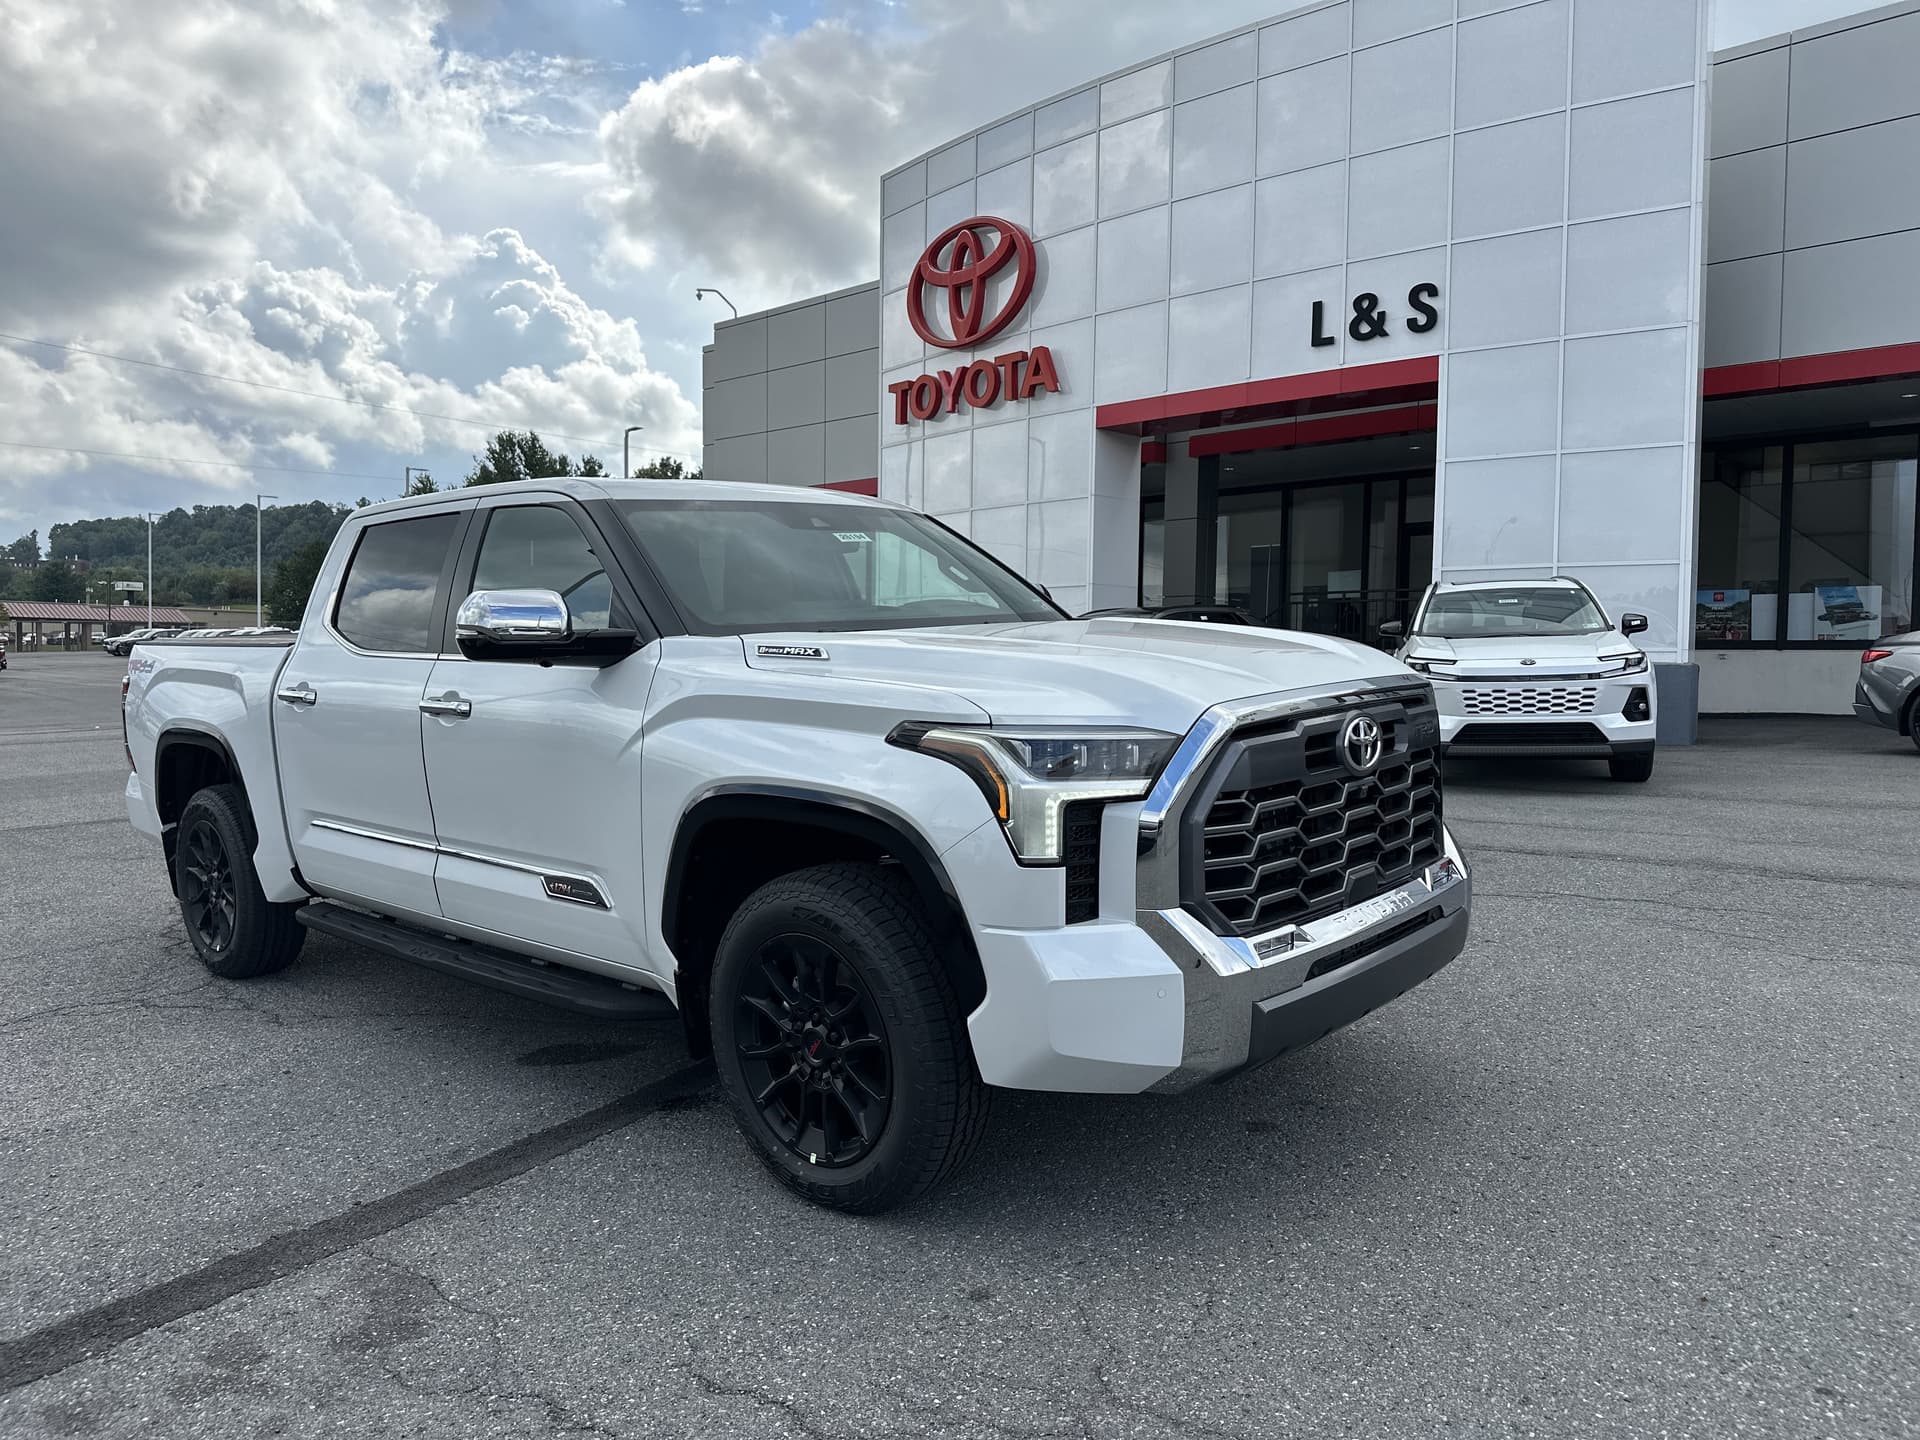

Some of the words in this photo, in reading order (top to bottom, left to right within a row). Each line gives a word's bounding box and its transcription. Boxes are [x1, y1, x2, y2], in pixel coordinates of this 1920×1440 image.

[1311, 300, 1335, 347] L
[1349, 292, 1390, 342] &
[1406, 282, 1439, 334] S
[888, 346, 1060, 425] TOYOTA
